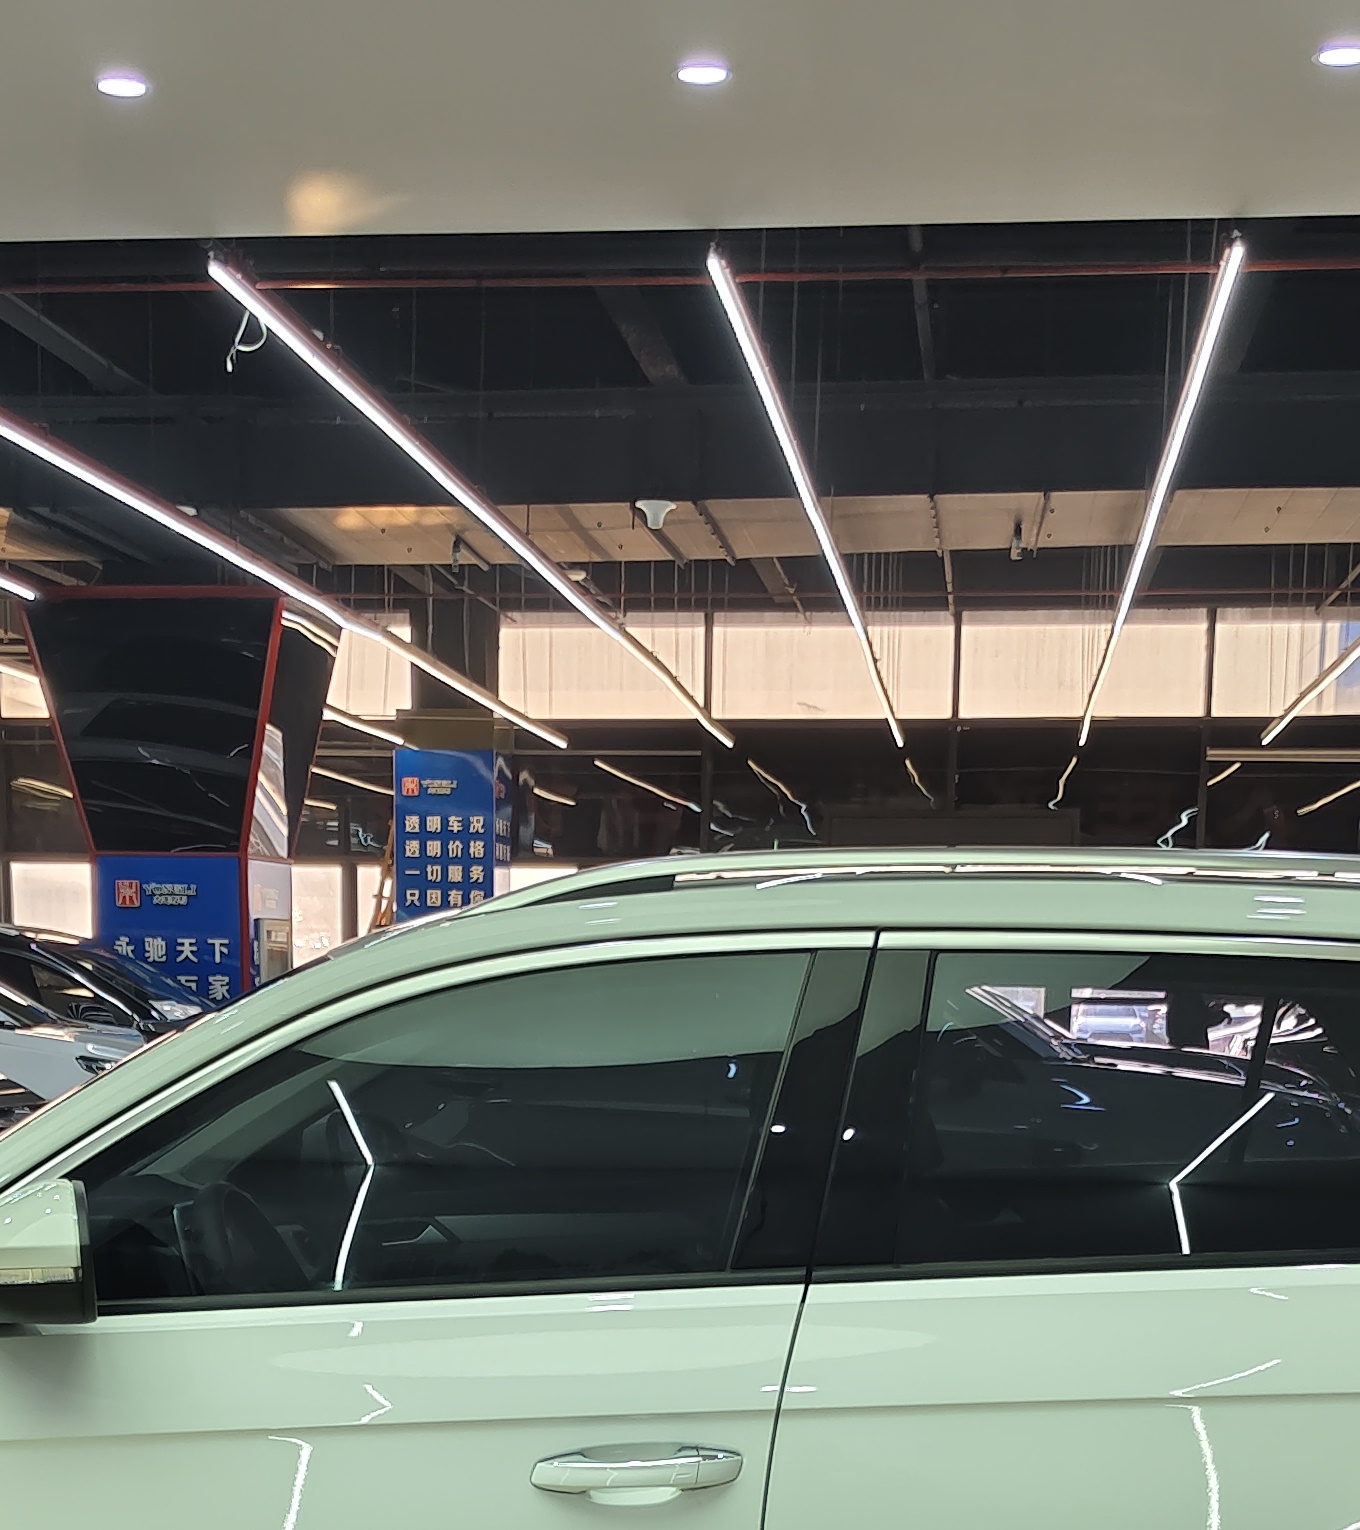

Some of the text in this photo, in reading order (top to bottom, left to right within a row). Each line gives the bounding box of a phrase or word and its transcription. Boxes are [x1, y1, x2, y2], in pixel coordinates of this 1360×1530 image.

[404, 815, 486, 834] 透明车况
[404, 840, 486, 859] 透明价格
[404, 865, 485, 883] 一切服务
[113, 936, 230, 964] 永驰天下
